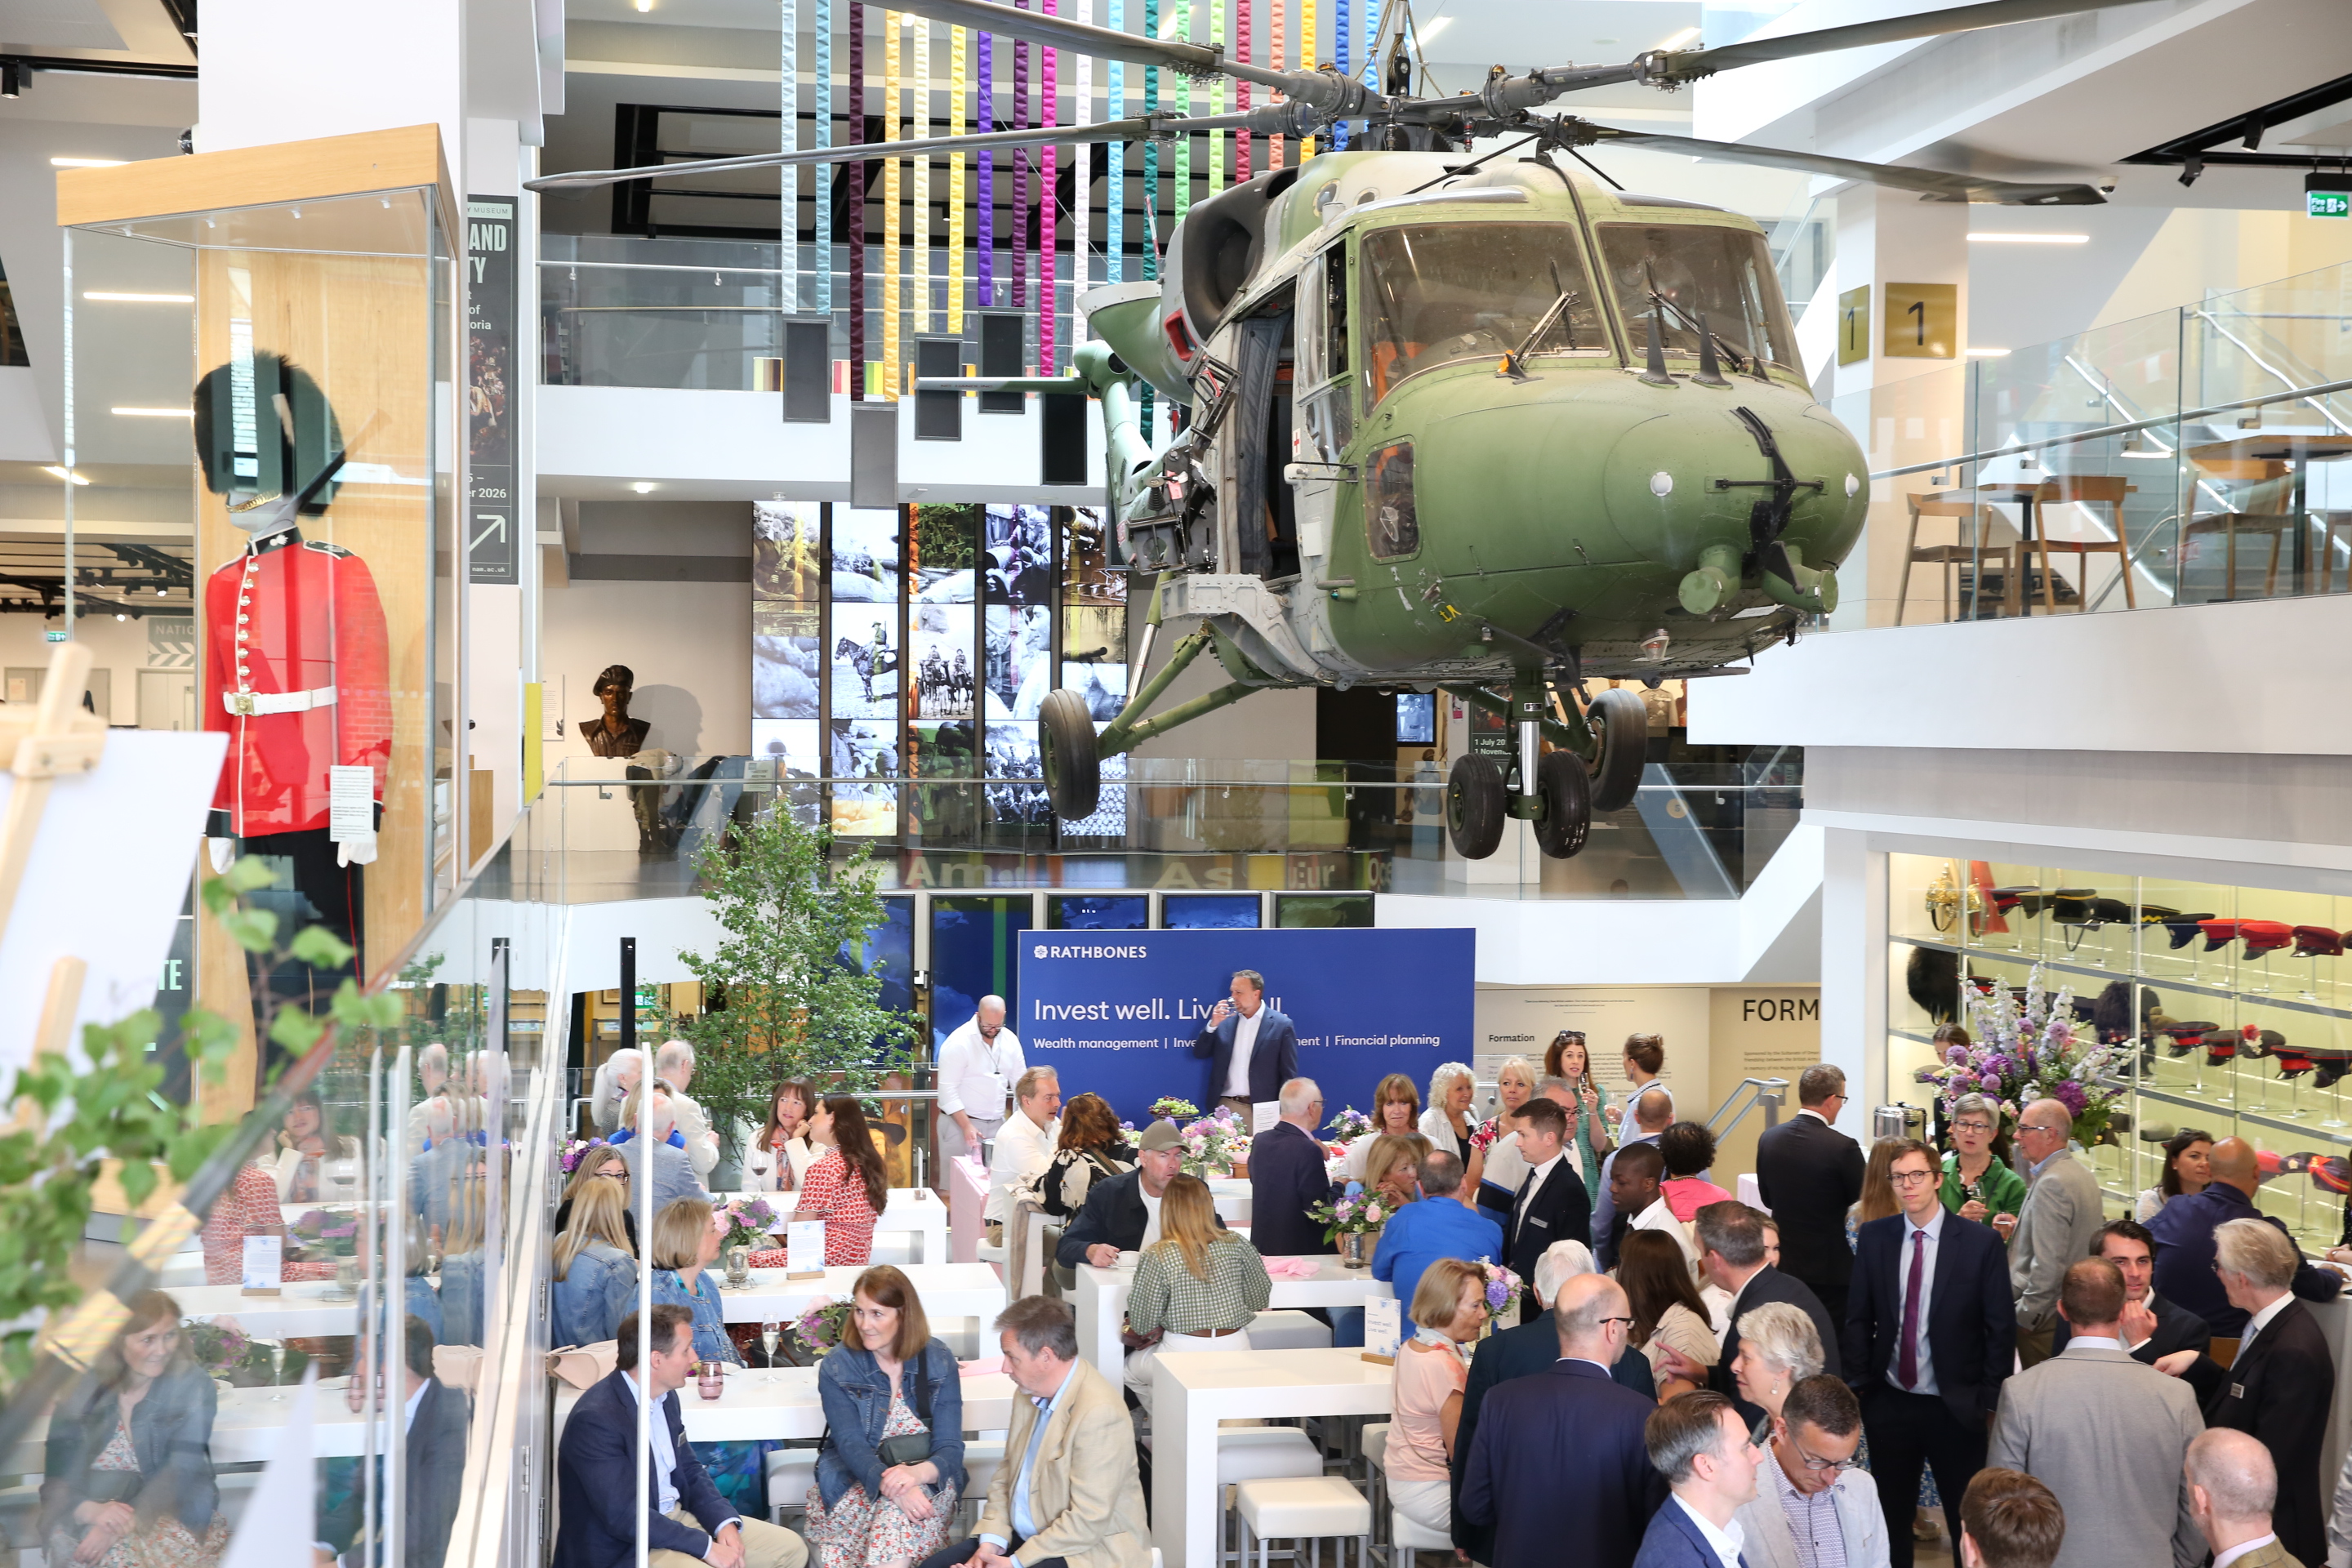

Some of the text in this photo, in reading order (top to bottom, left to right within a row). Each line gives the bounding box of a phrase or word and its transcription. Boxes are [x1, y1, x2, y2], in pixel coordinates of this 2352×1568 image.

[469, 319, 492, 330] oria
[1846, 291, 1855, 351] 1
[1908, 301, 1924, 346] 1
[478, 488, 507, 498] 2026
[155, 624, 194, 635] NATIO
[1481, 738, 1495, 747] July
[1050, 946, 1147, 959] RATHBONES
[158, 959, 182, 991] TE
[1035, 999, 1110, 1020] Invest
[1115, 998, 1170, 1020] well.
[1178, 997, 1214, 1019] Liv
[1033, 1037, 1076, 1049] Wealth
[1078, 1038, 1159, 1051] management
[1174, 1037, 1196, 1048] Inve
[1335, 1034, 1388, 1046] Financial
[1390, 1034, 1441, 1048] planning
[1489, 1033, 1535, 1042] Formation
